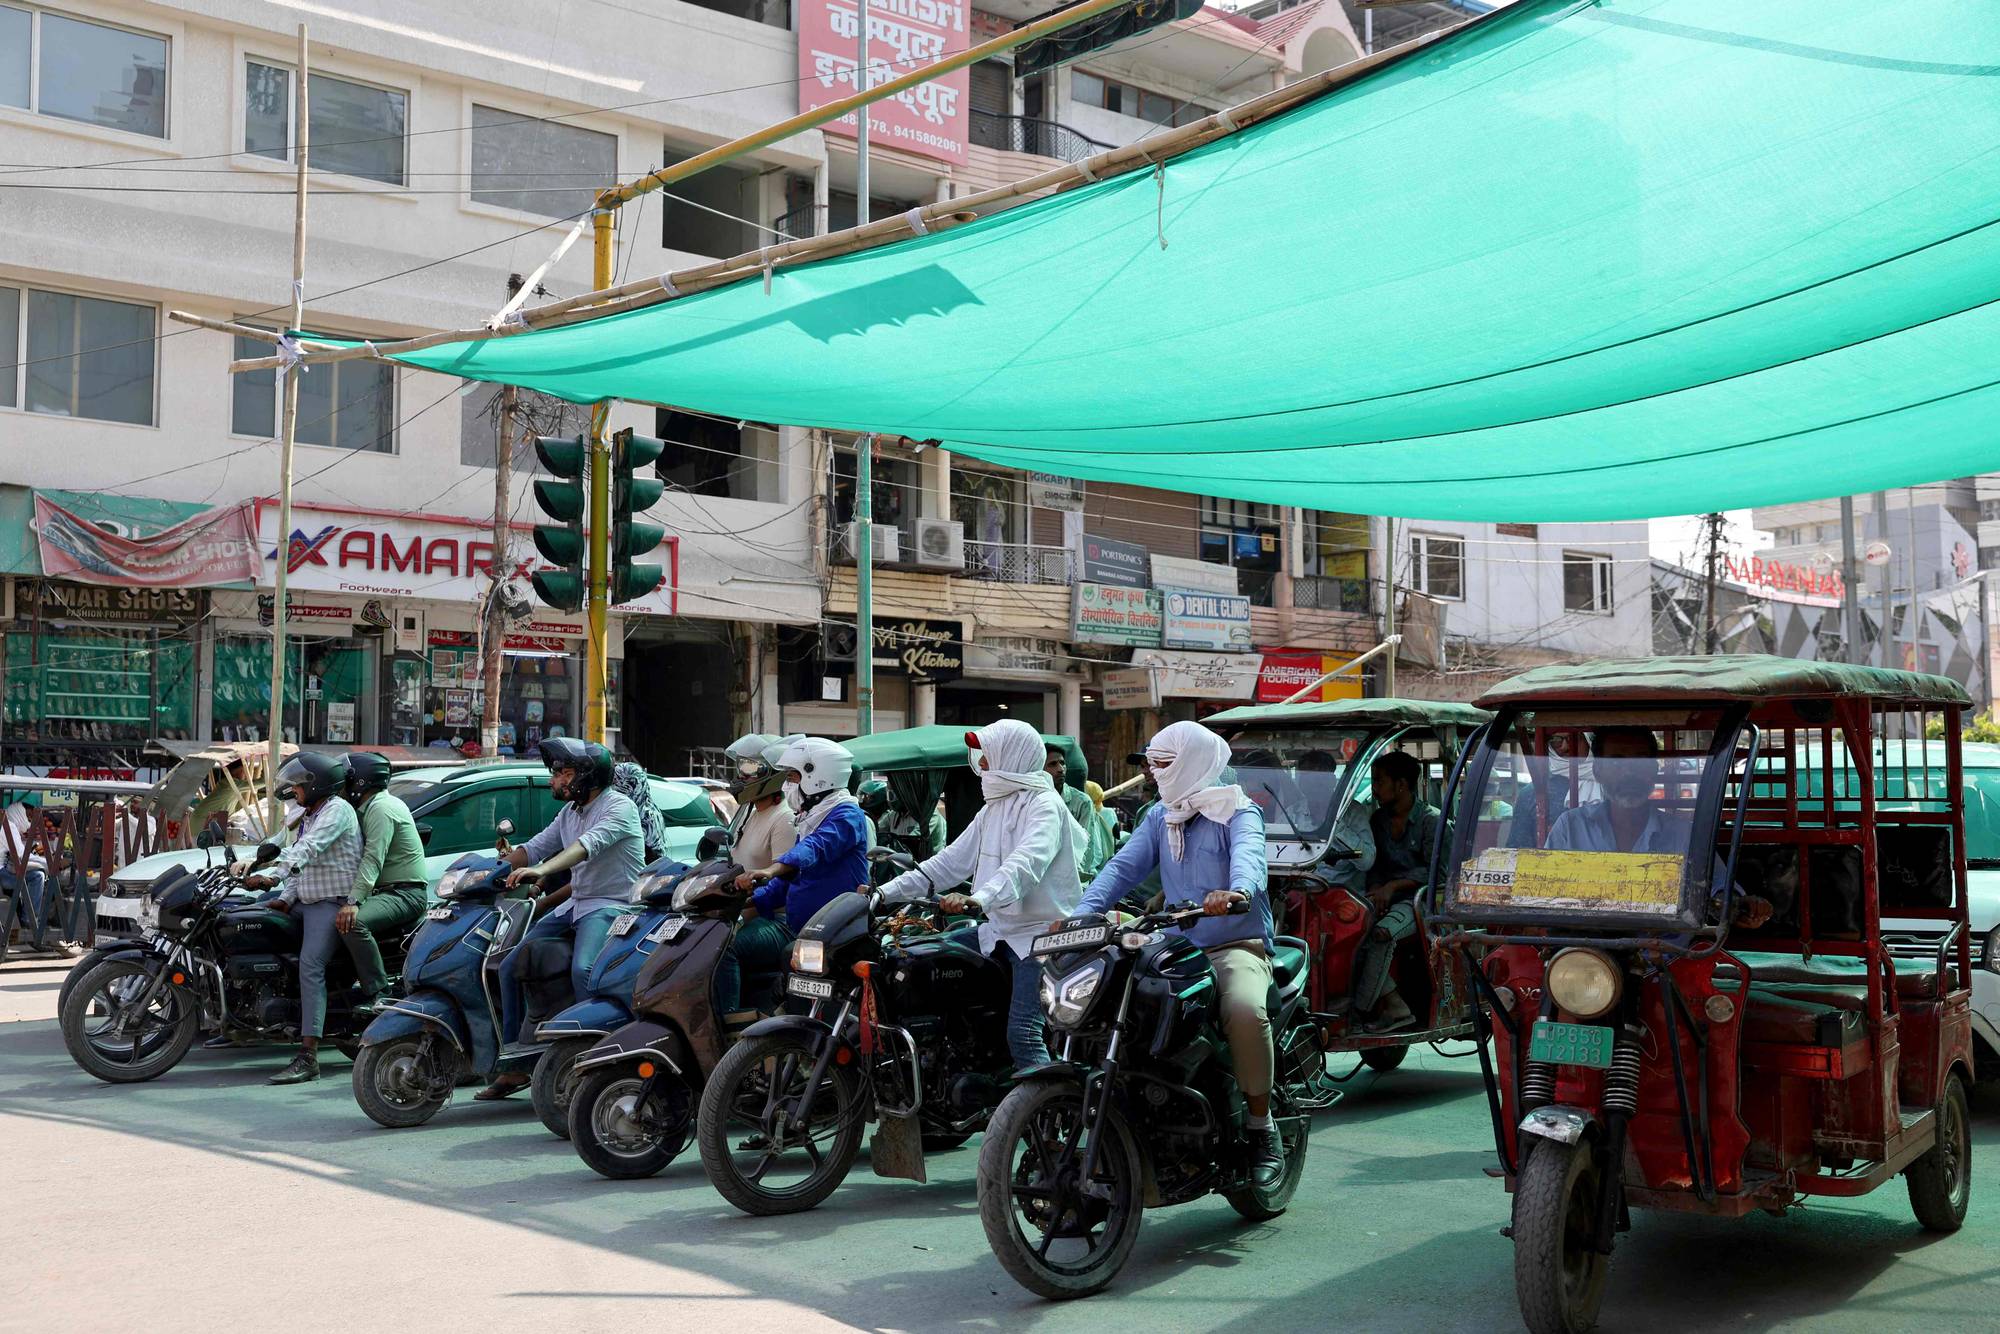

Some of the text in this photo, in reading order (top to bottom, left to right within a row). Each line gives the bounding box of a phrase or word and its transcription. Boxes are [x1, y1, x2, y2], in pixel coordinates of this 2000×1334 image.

[1101, 549, 1143, 566] PORTRONICS
[339, 583, 412, 595] Footwears
[41, 586, 196, 612] AMAR SHOES
[104, 610, 121, 618] FOR
[1185, 596, 1248, 619] DENTAL CLINIC
[533, 637, 560, 647] SALE
[903, 647, 961, 676] Kitchen
[1263, 666, 1320, 677] AMERICAN
[1066, 919, 1083, 928] TVS
[1546, 1043, 1601, 1064] T2133
